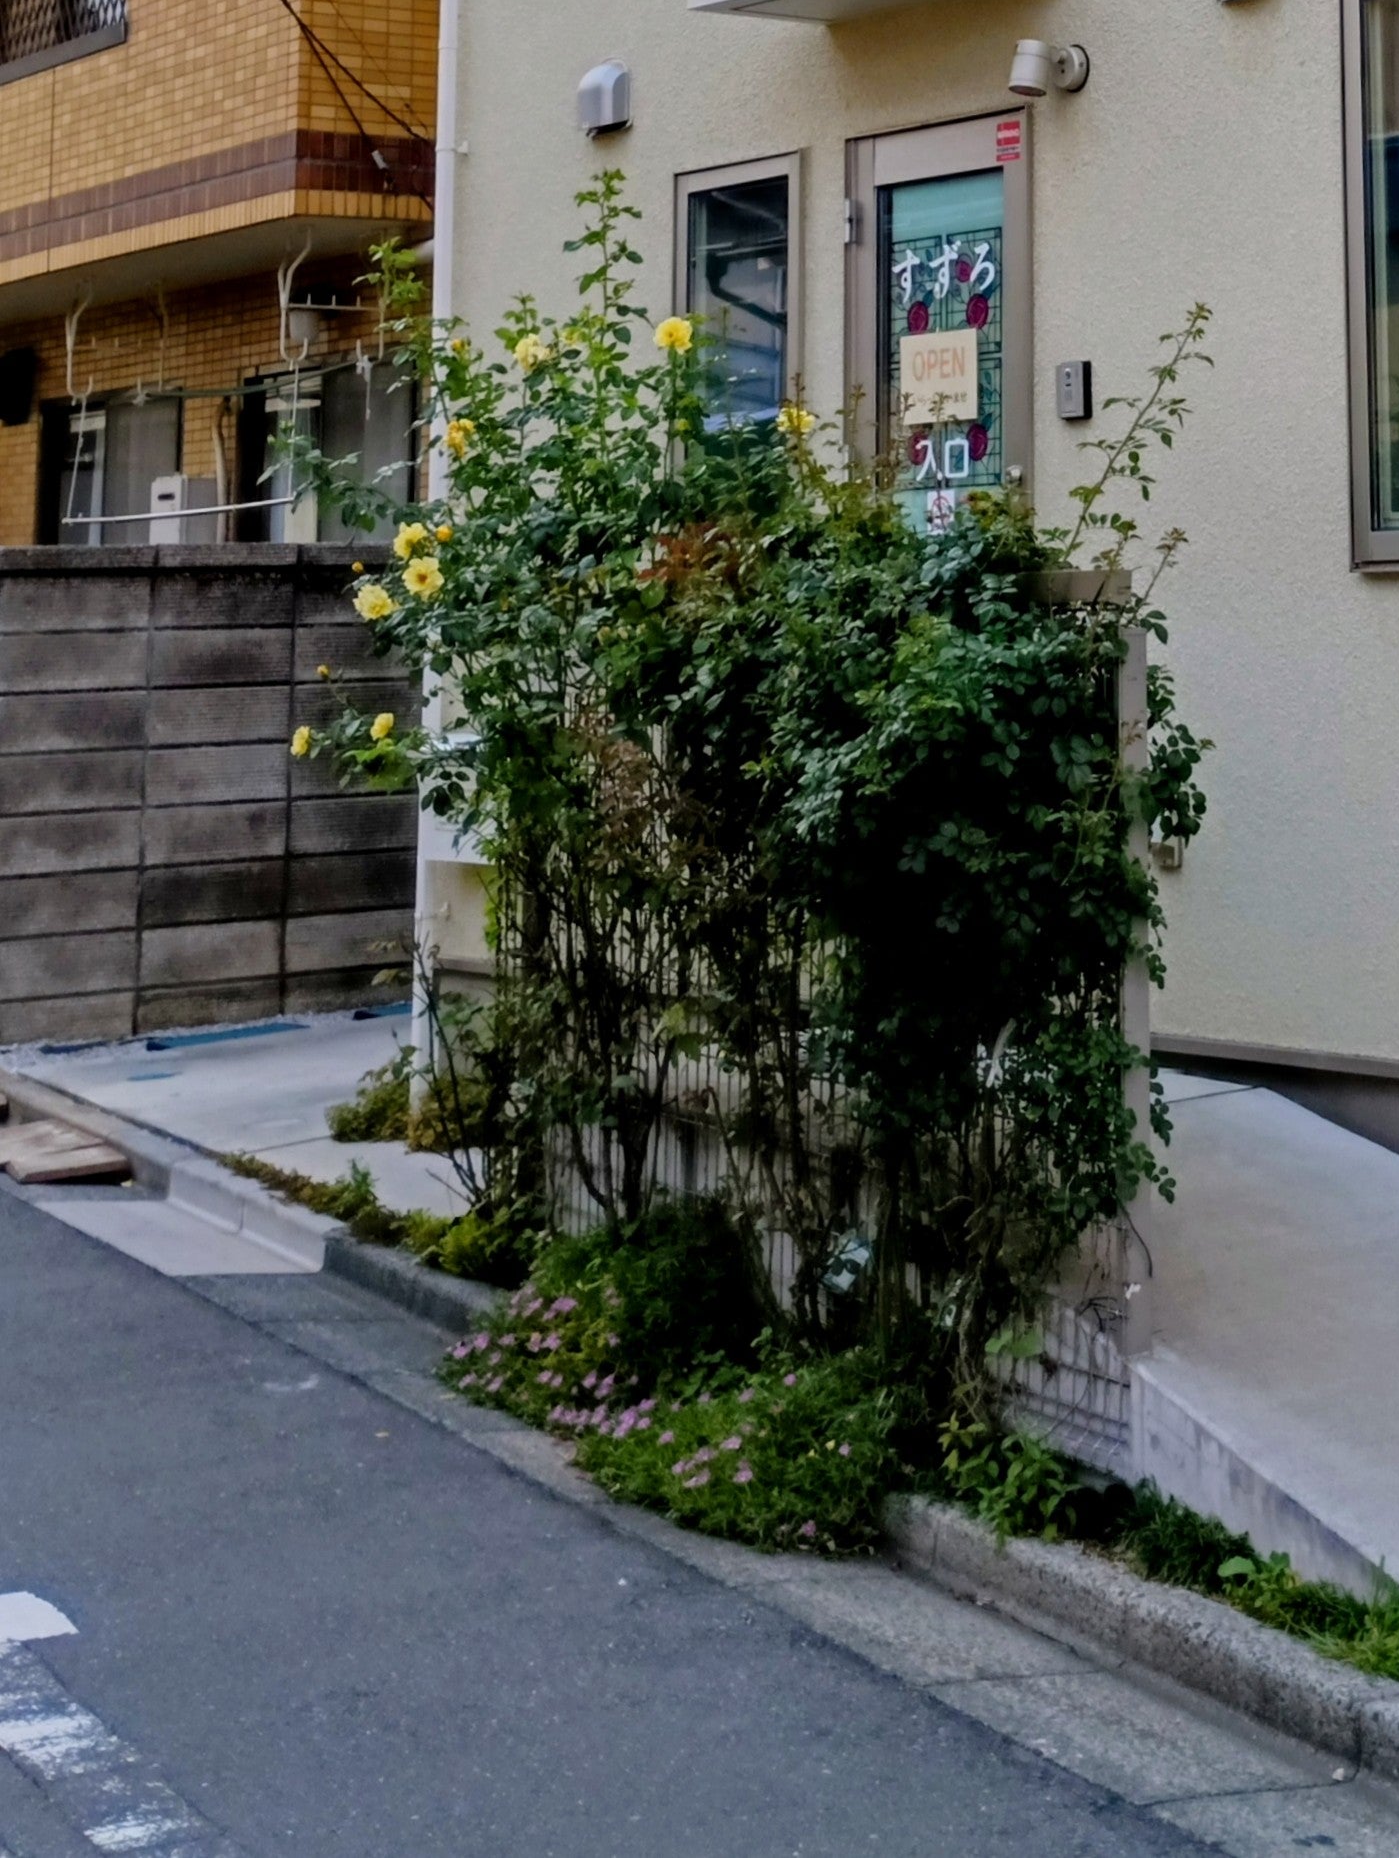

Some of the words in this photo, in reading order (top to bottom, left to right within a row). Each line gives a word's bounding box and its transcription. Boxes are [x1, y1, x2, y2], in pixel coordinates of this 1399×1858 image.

[892, 240, 996, 304] すずろ
[912, 346, 966, 382] OPEN
[915, 438, 969, 482] 入口
